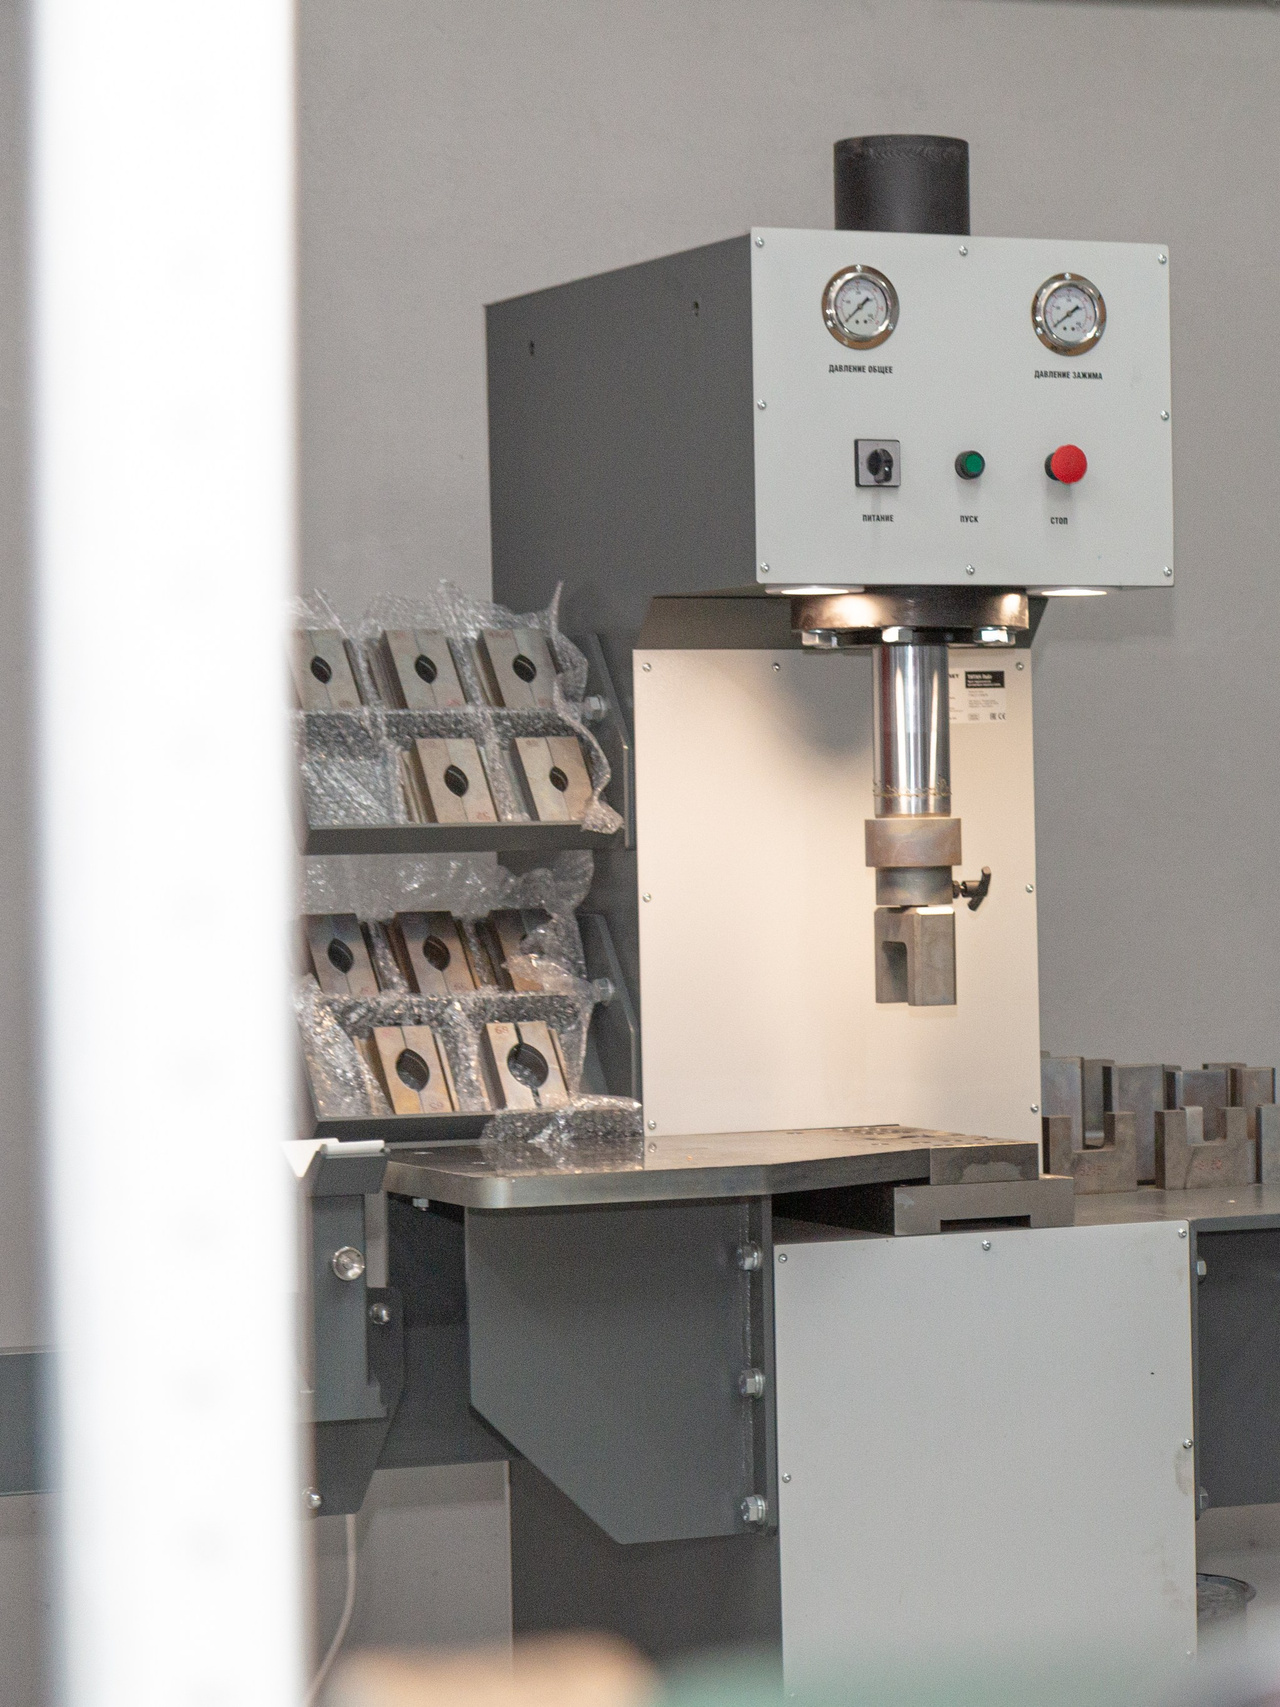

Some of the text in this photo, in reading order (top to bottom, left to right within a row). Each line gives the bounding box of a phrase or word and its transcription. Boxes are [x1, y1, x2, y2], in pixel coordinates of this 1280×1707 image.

[828, 364, 893, 374] ДАВЛЕНИЕ ОБЩЕЕ
[1034, 370, 1103, 380] ДАВЛЕНИЕ ЗАЖИМА
[862, 514, 894, 523] ПИТАНИЕ
[960, 515, 979, 523] ПУСК
[1050, 516, 1068, 525] СТОП
